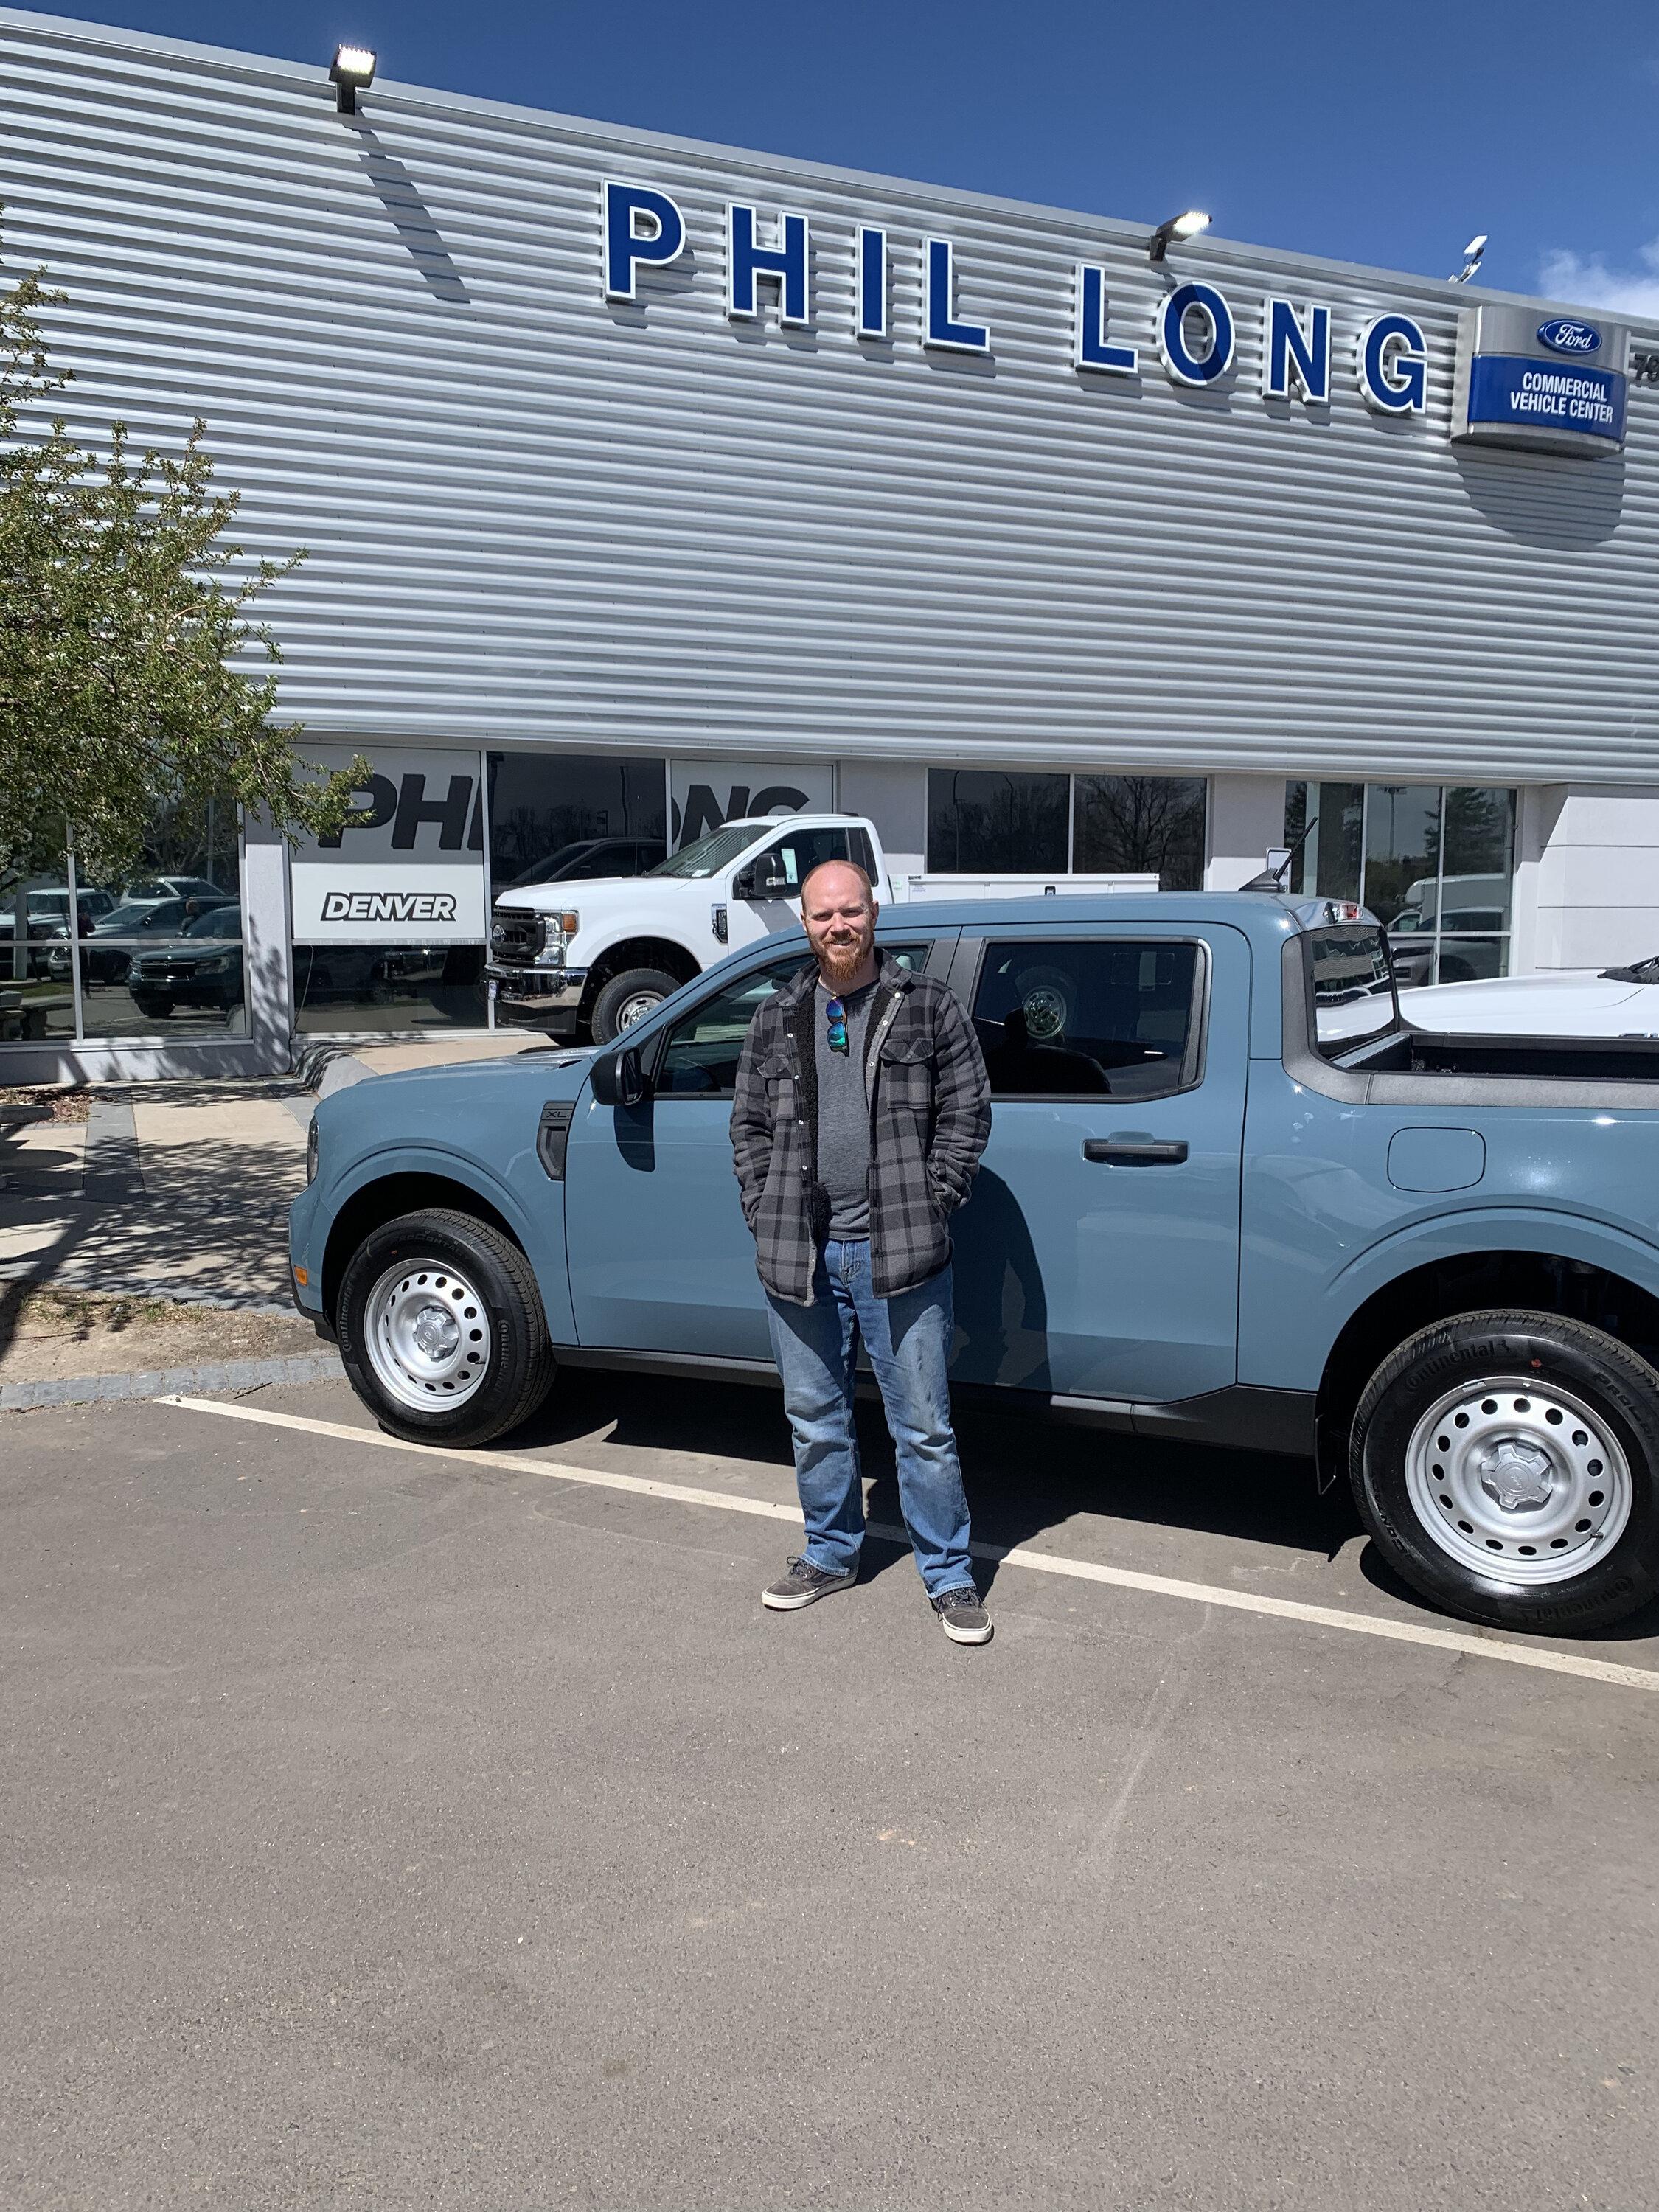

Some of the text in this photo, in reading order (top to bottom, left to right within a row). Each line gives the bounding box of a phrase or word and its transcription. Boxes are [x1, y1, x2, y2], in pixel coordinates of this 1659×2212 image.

[603, 178, 1428, 414] PHIL LONG
[1554, 324, 1593, 349] Ford
[1522, 372, 1607, 402] COMMERCIAL
[1510, 391, 1613, 424] VEHICLE CENTER
[321, 892, 457, 922] DENVER
